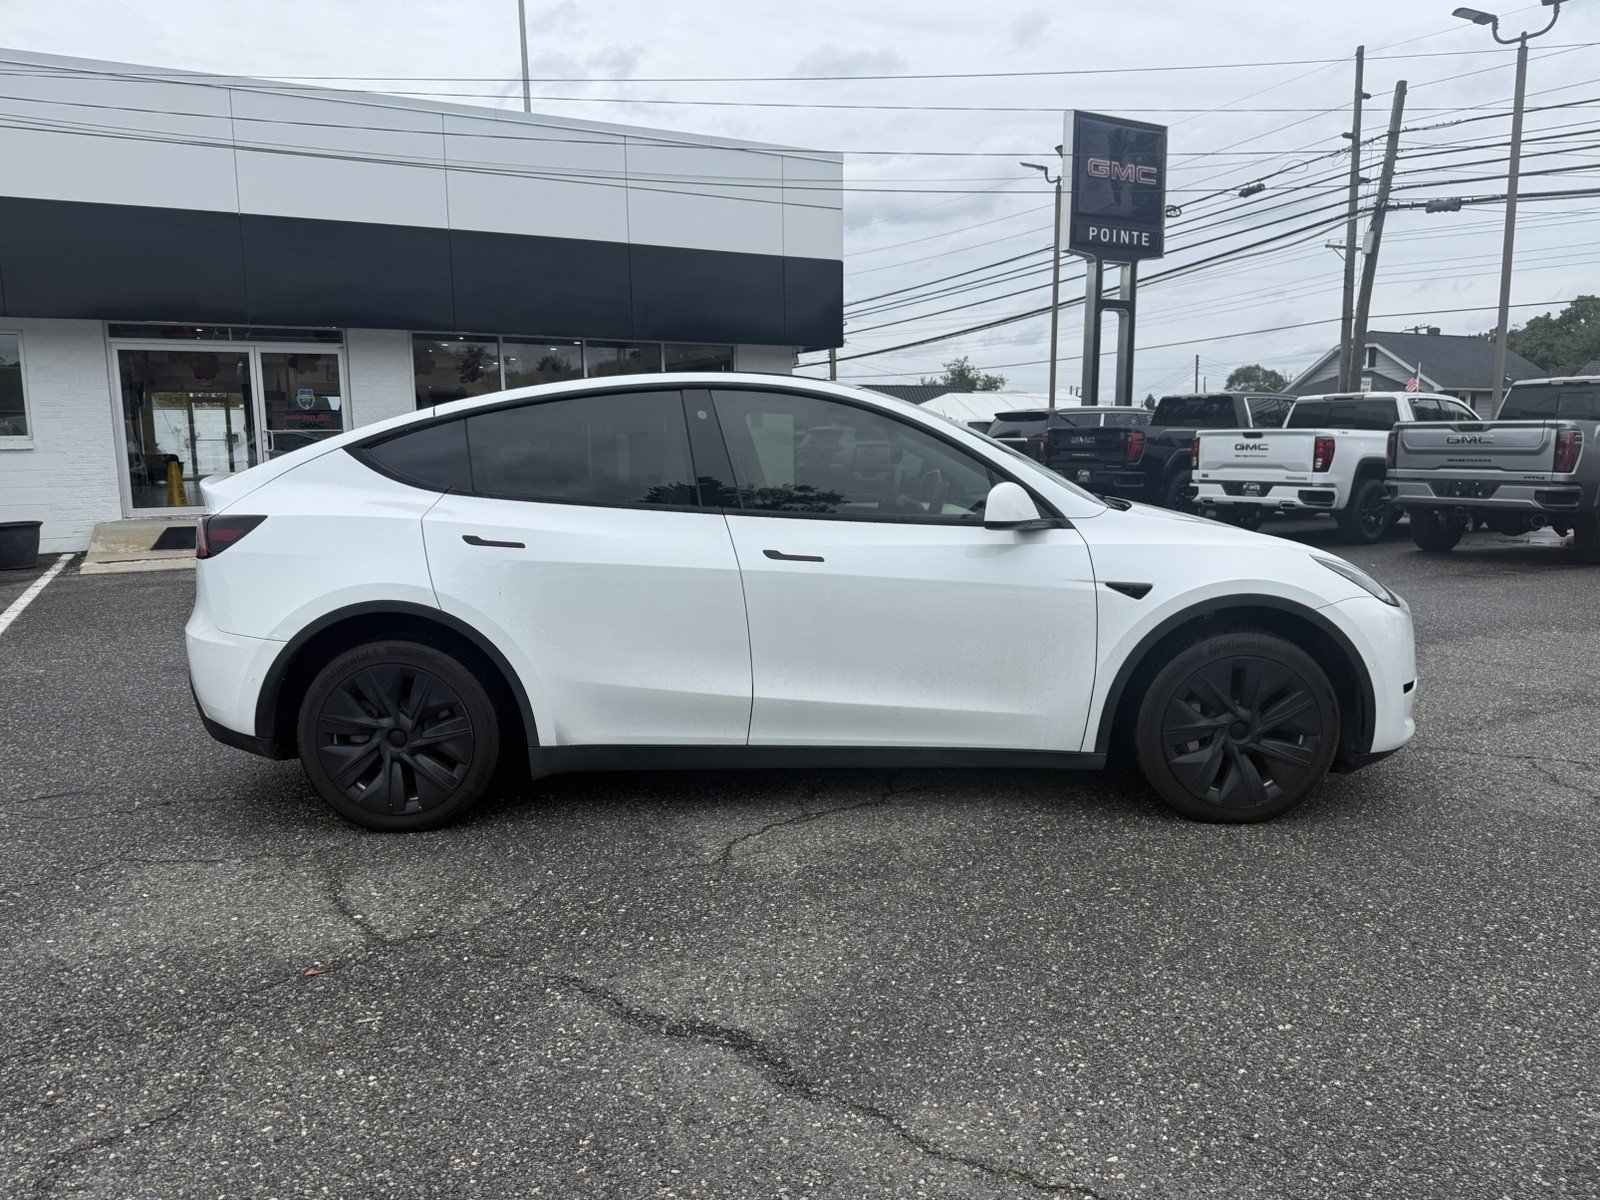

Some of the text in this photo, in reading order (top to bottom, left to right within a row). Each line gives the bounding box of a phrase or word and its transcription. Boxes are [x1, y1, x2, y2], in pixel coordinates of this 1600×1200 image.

[1088, 158, 1157, 185] GMC
[1089, 227, 1150, 246] POINTE
[1447, 435, 1494, 444] GMC
[1235, 443, 1269, 451] GMC
